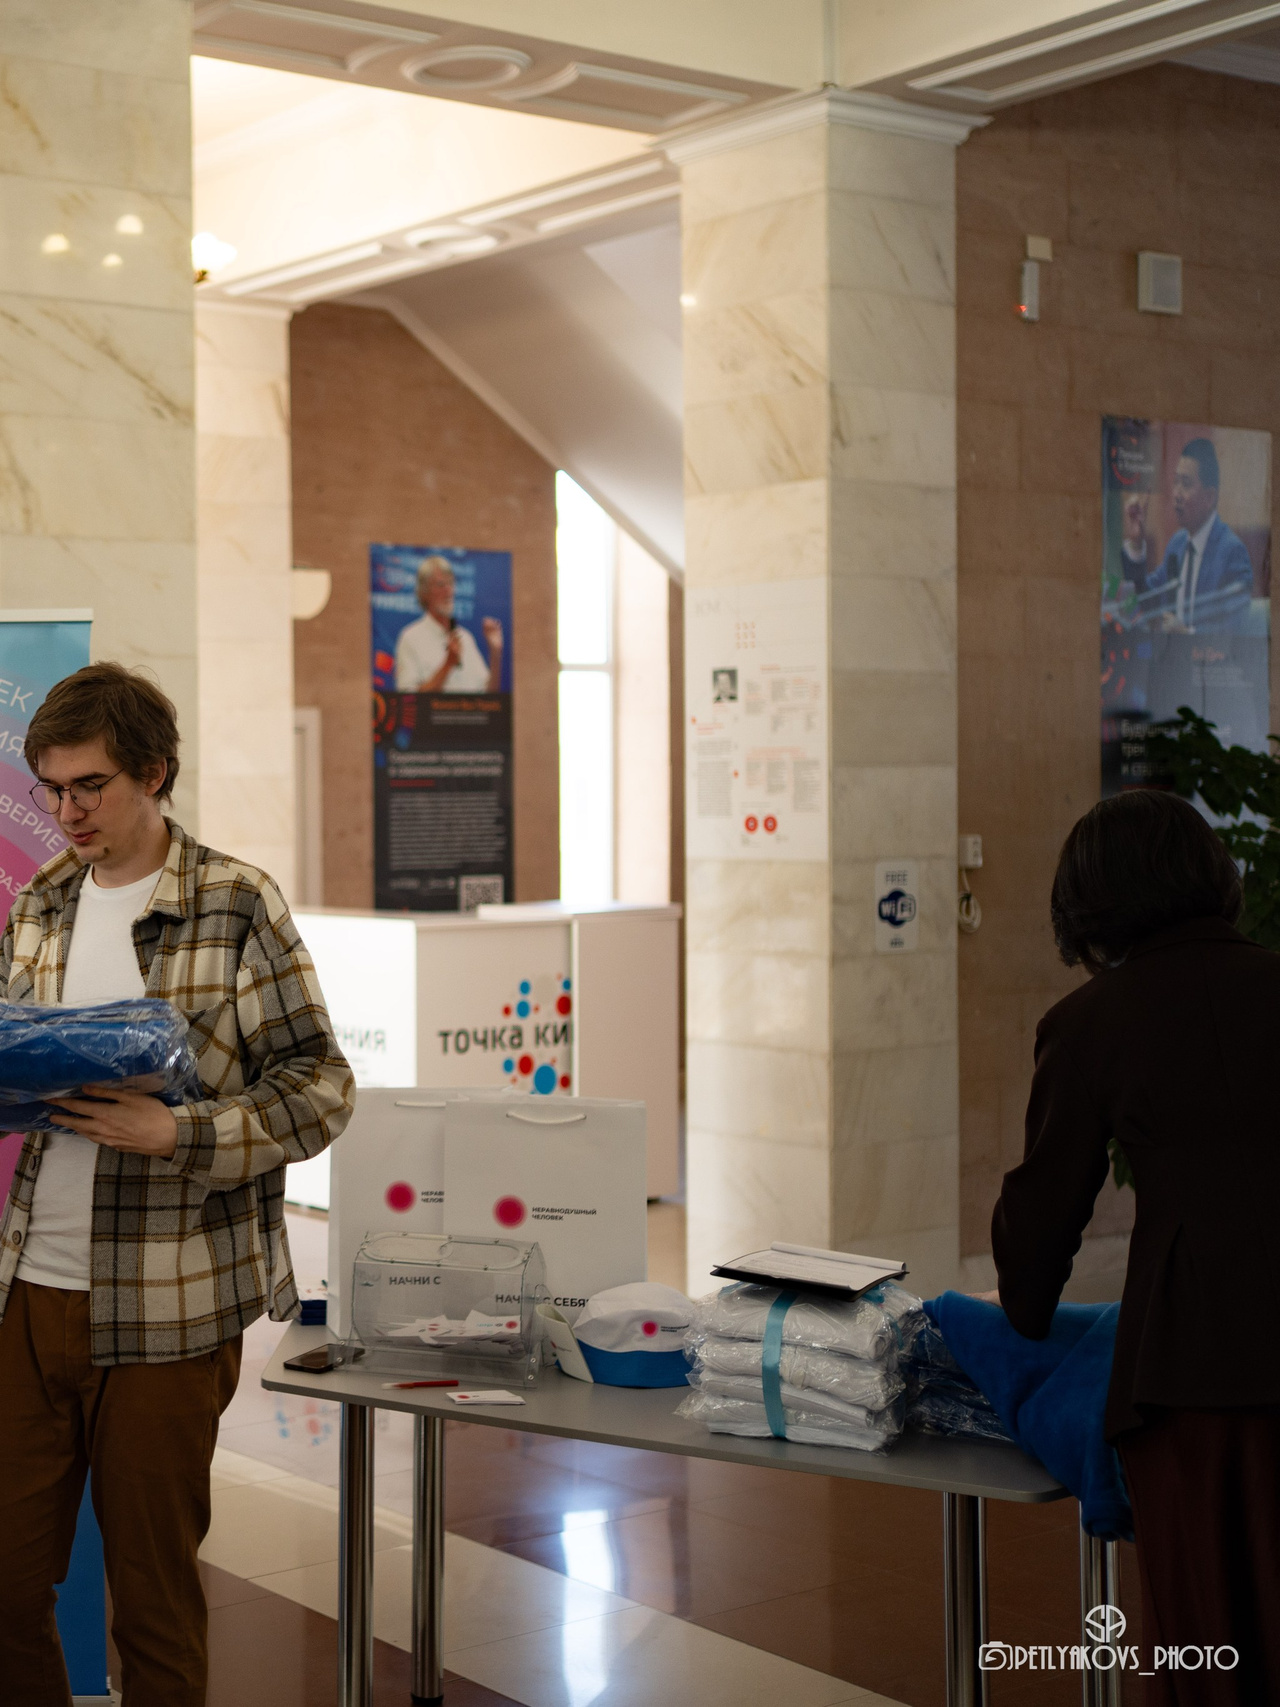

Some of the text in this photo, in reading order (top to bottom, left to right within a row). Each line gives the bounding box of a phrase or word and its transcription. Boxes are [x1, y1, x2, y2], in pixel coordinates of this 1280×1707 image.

[532, 1207, 597, 1215] НЕРАВНОДУШНЫЙ
[389, 1276, 441, 1285] НАЧНИ С
